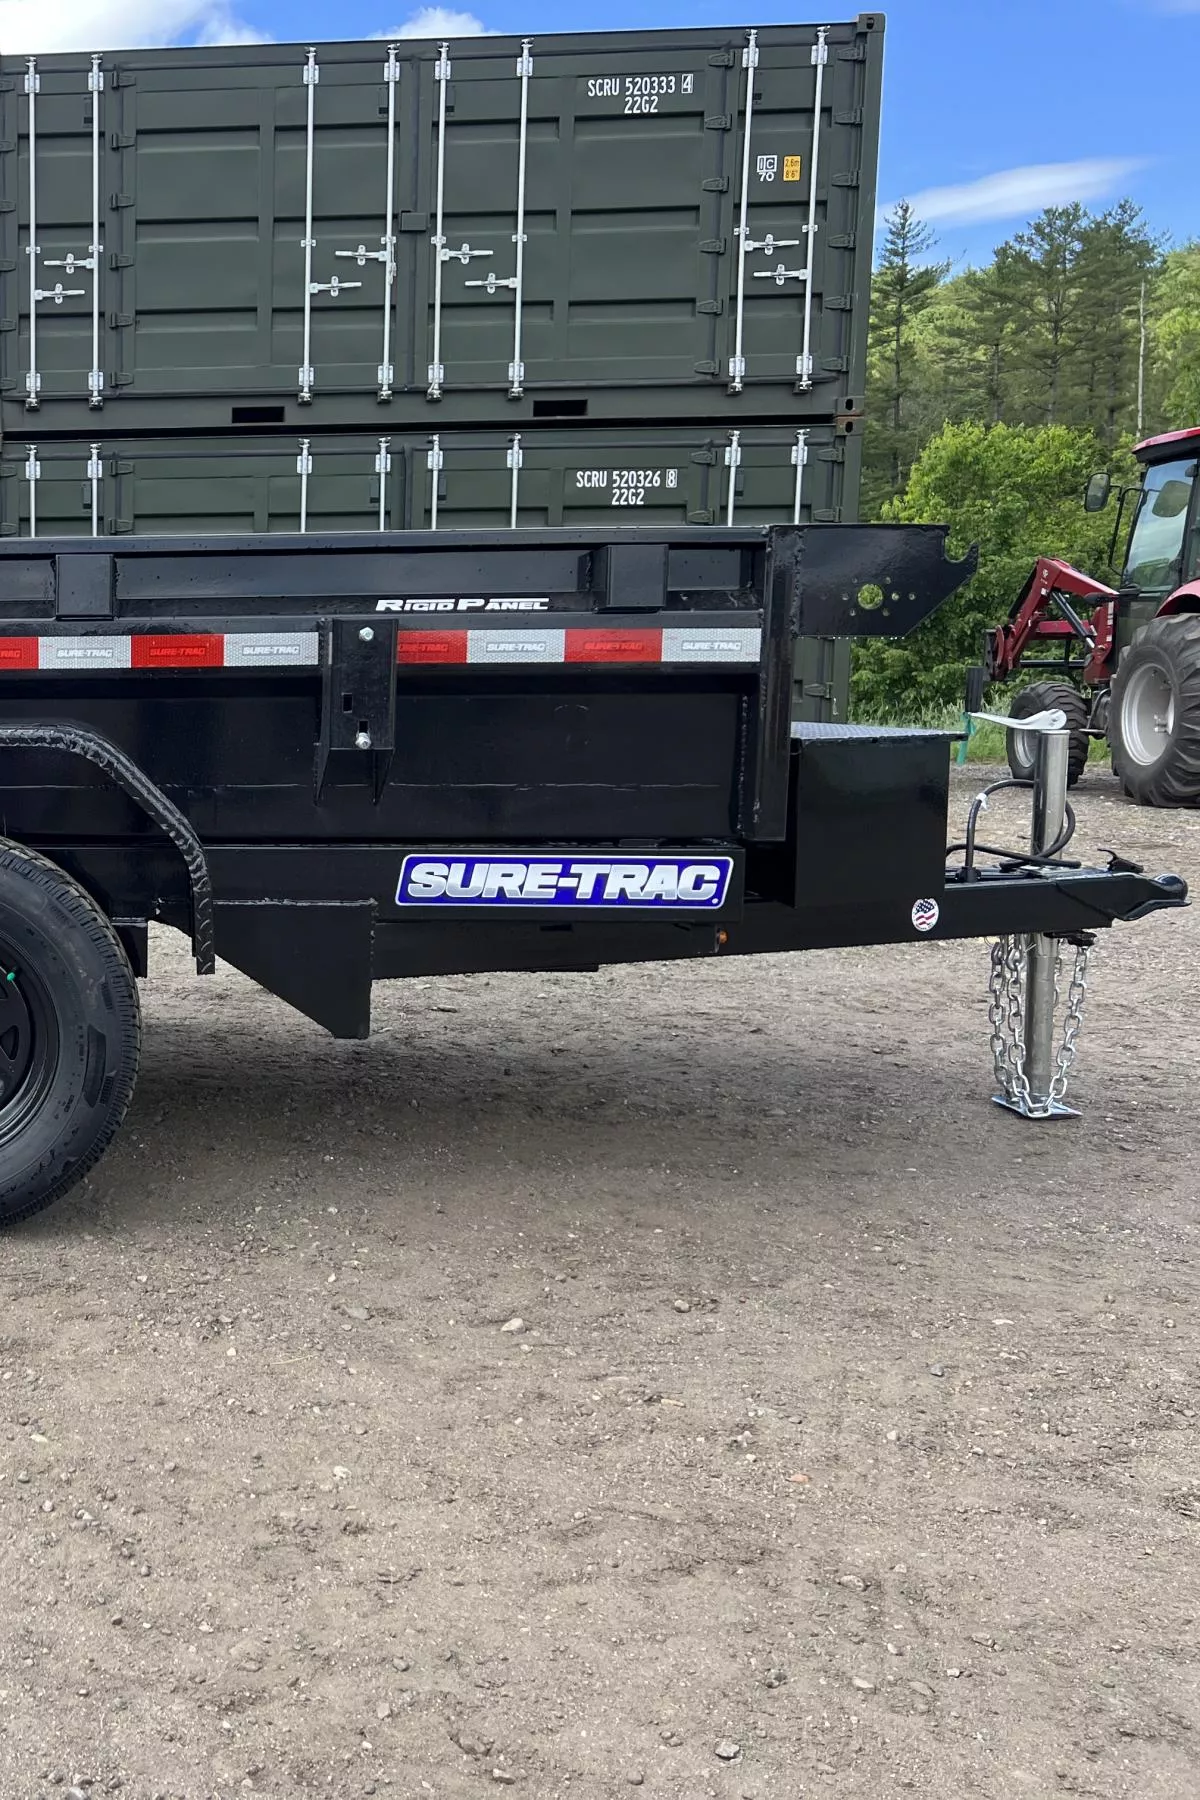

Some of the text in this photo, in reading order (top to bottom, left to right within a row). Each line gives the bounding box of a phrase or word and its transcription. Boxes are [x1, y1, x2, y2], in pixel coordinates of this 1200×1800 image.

[587, 74, 693, 96] SCRU 520333 4
[624, 95, 659, 114] 22G2
[758, 172, 775, 182] 70
[576, 469, 677, 488] SCRU 520326 8
[611, 488, 645, 505] 22G2
[376, 598, 549, 612] RIGID PANEL
[243, 646, 299, 655] SURE-TRAC
[400, 643, 449, 652] URE-TRAC
[487, 643, 545, 652] SURE-TRAC
[585, 642, 643, 650] SURE-TRAC
[683, 641, 741, 650] SURE-TRAC
[57, 649, 113, 658] SURE-TRAC
[150, 646, 205, 656] SURE-TRAC
[407, 862, 721, 900] SURE-TRAC
